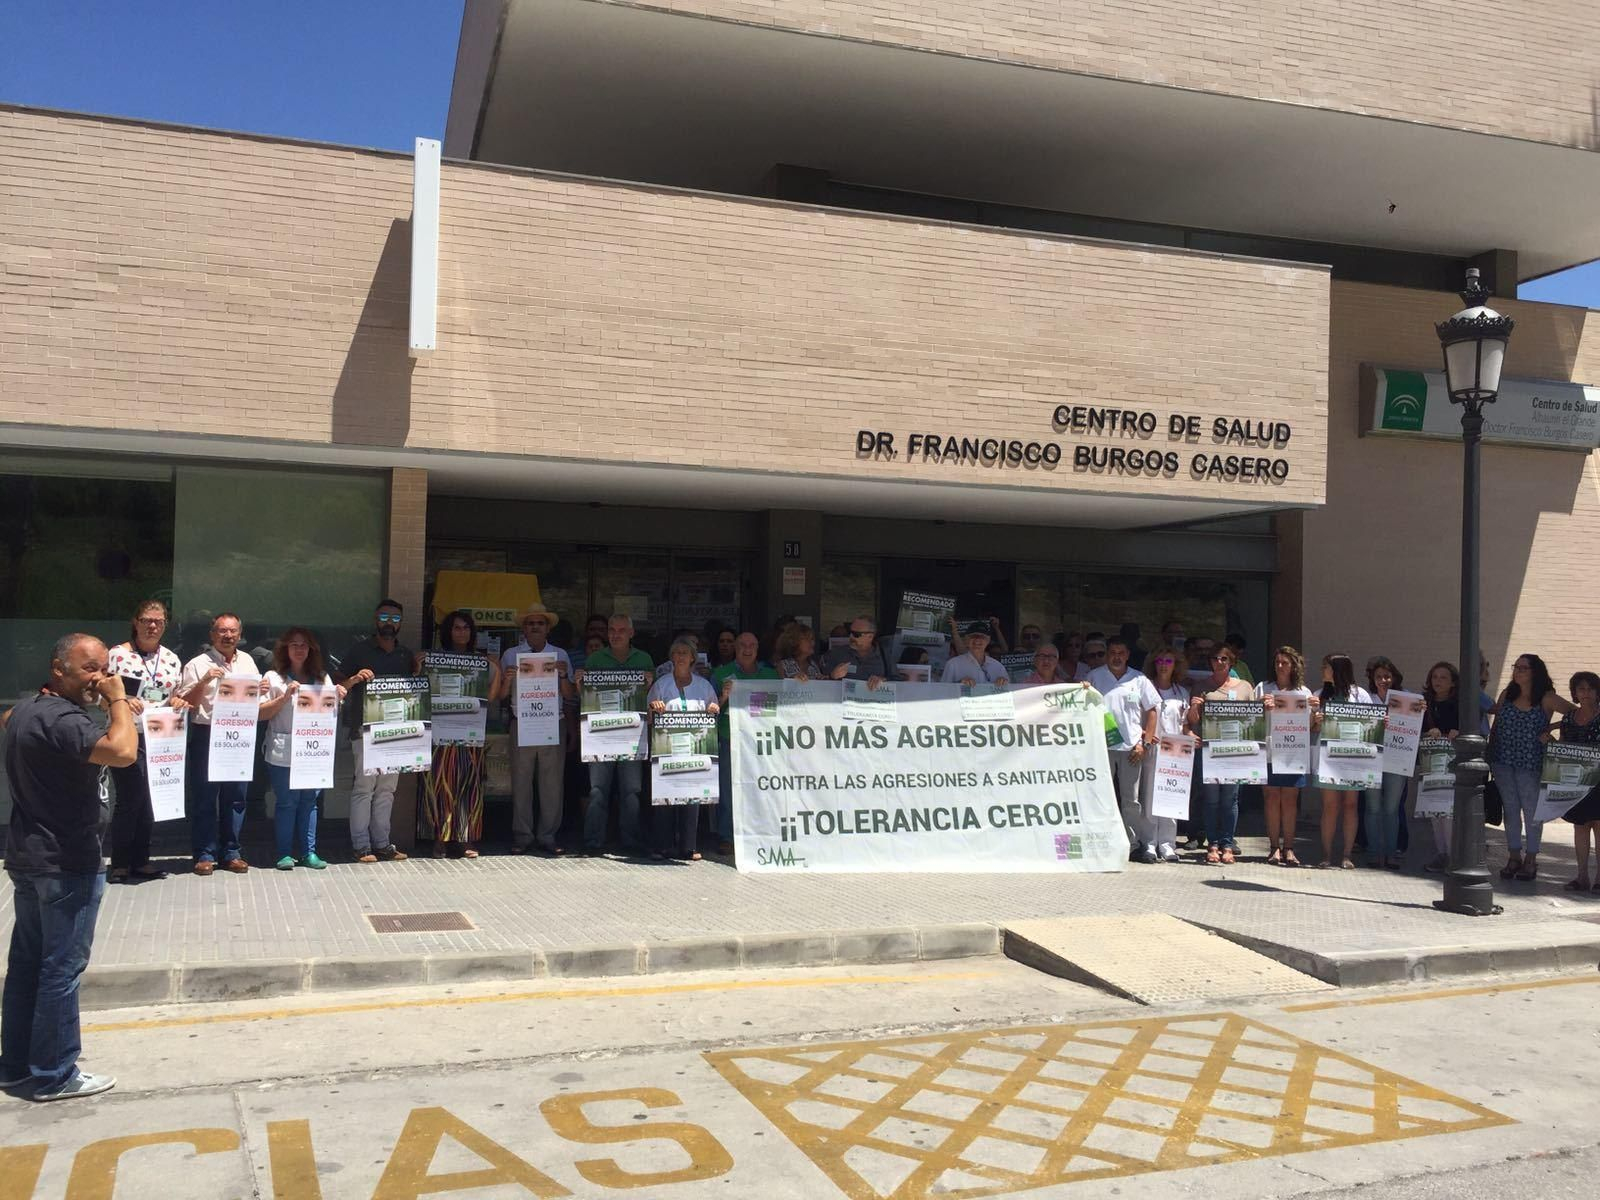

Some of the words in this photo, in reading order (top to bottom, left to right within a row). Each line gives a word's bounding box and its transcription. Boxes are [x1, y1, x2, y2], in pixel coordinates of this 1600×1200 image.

[1532, 397, 1560, 409] Centro
[1562, 399, 1572, 411] de
[1574, 400, 1597, 414] Salud
[1054, 405, 1157, 433] CENTRO
[1170, 414, 1202, 437] DE
[1214, 417, 1291, 443] SALUD
[1508, 422, 1543, 437] Francisco
[1544, 425, 1569, 440] Burgos
[858, 430, 898, 454] DR.
[910, 434, 1061, 464] FRANCISCO
[1074, 445, 1179, 473] BURGOS
[1192, 453, 1289, 479] CASERO
[903, 595, 955, 609] RECOMENDADO
[474, 611, 512, 621] ONCE
[425, 656, 488, 668] RECOMENDADO
[366, 681, 429, 691] RECOMENDADO
[531, 702, 543, 711] NO
[1204, 706, 1264, 714] RECOMENDADO
[1325, 706, 1387, 717] RECOMENDADO
[215, 718, 255, 728] AGRESIÓN
[591, 717, 633, 728] RESPETO
[655, 717, 716, 725] RECOMENDADO
[225, 731, 239, 741] NO
[374, 727, 418, 738] RESPETO
[756, 725, 816, 756] ¡¡NO
[824, 720, 888, 749] MÁS
[897, 724, 1086, 749] AGRESIONES!!
[1284, 734, 1295, 743] NO
[1392, 735, 1404, 744] NO
[306, 740, 319, 750] NO
[1212, 746, 1252, 754] RESPETO
[1330, 746, 1370, 754] RESPETO
[662, 760, 705, 771] RESPETO
[160, 768, 171, 777] NO
[757, 775, 829, 791] CONTRA
[834, 774, 867, 790] LAS
[872, 772, 977, 789] AGRESIONES
[982, 772, 994, 786] A
[997, 768, 1097, 786] SANITARIOS
[1166, 778, 1177, 787] NO
[780, 807, 982, 842] ¡¡TOLERANCIA
[988, 801, 1080, 829] CERO!!
